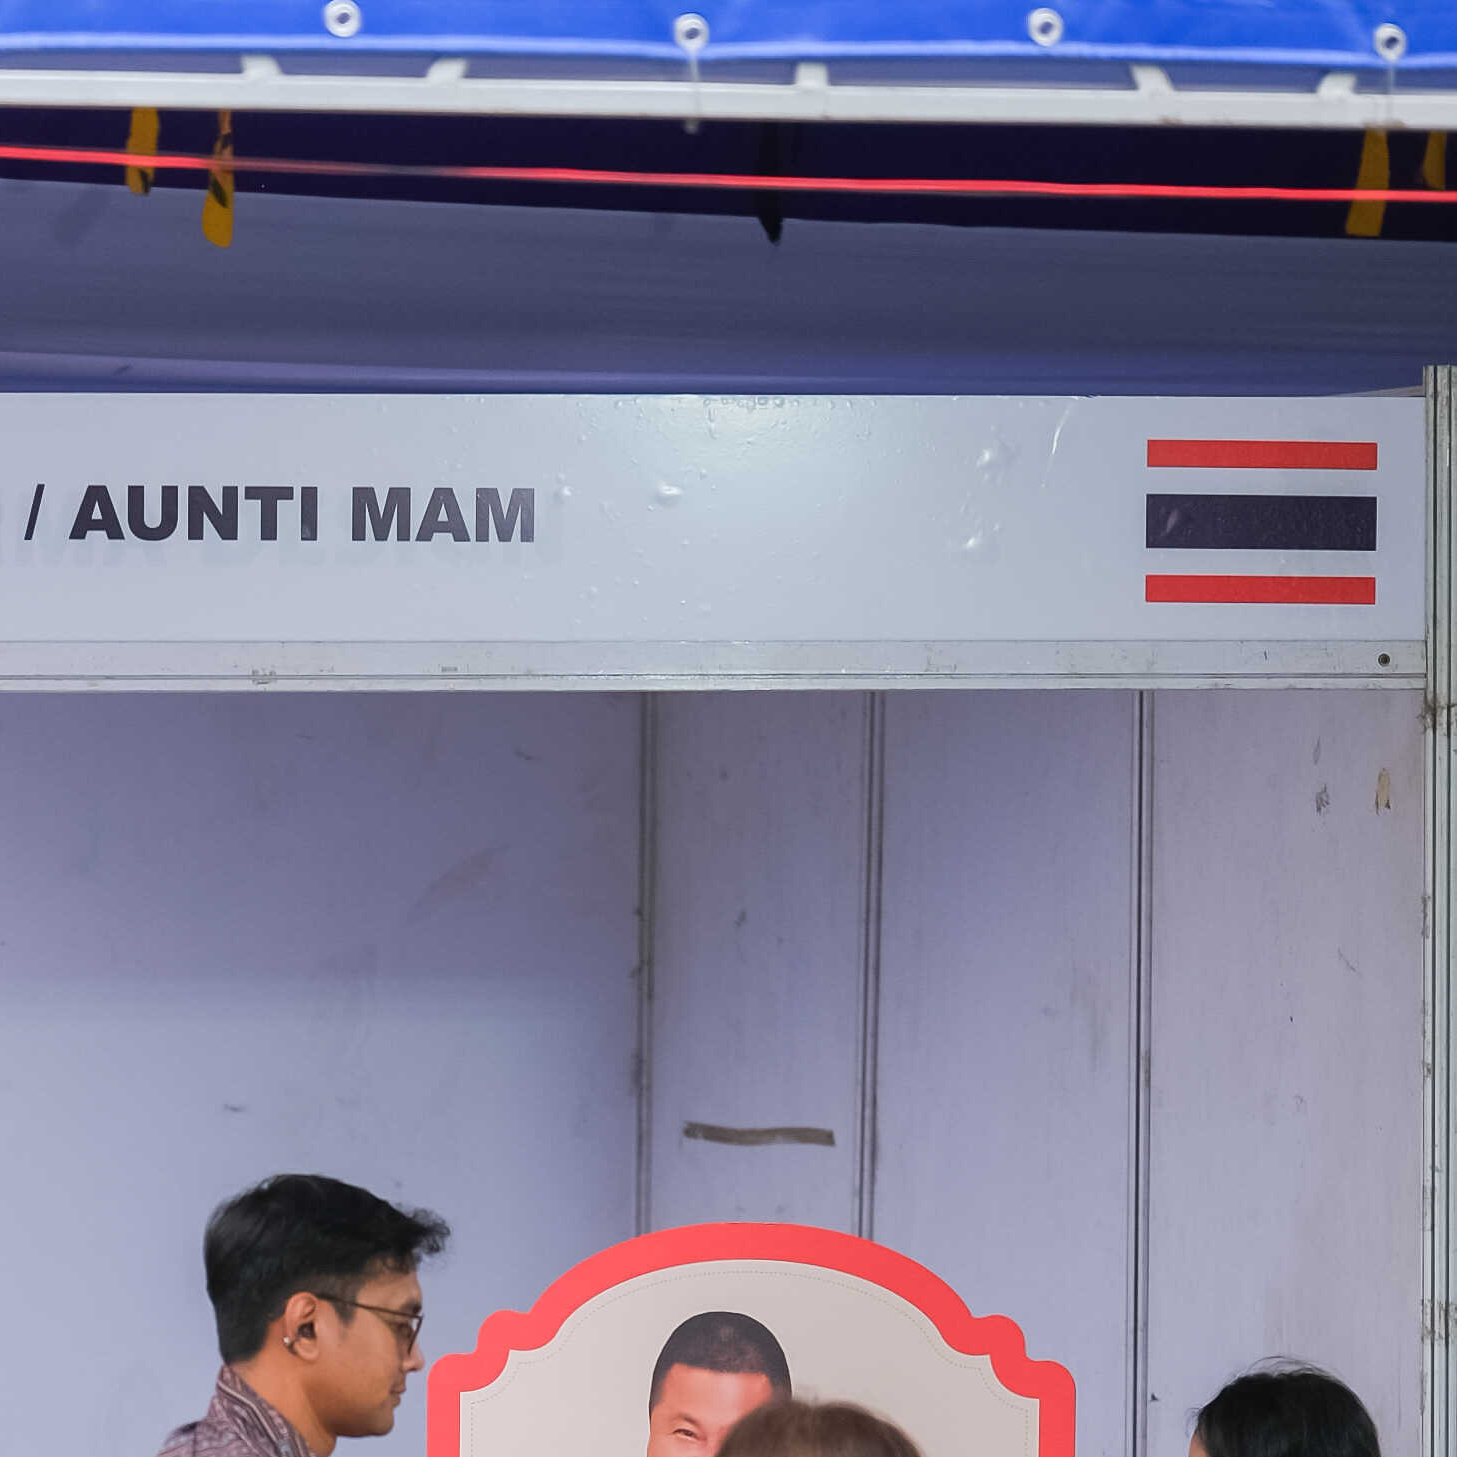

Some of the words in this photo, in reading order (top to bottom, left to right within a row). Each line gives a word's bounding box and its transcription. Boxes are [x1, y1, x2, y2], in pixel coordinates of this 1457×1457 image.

[23, 483, 45, 541] /
[68, 485, 318, 542] AUNTI
[351, 486, 536, 543] MAM
